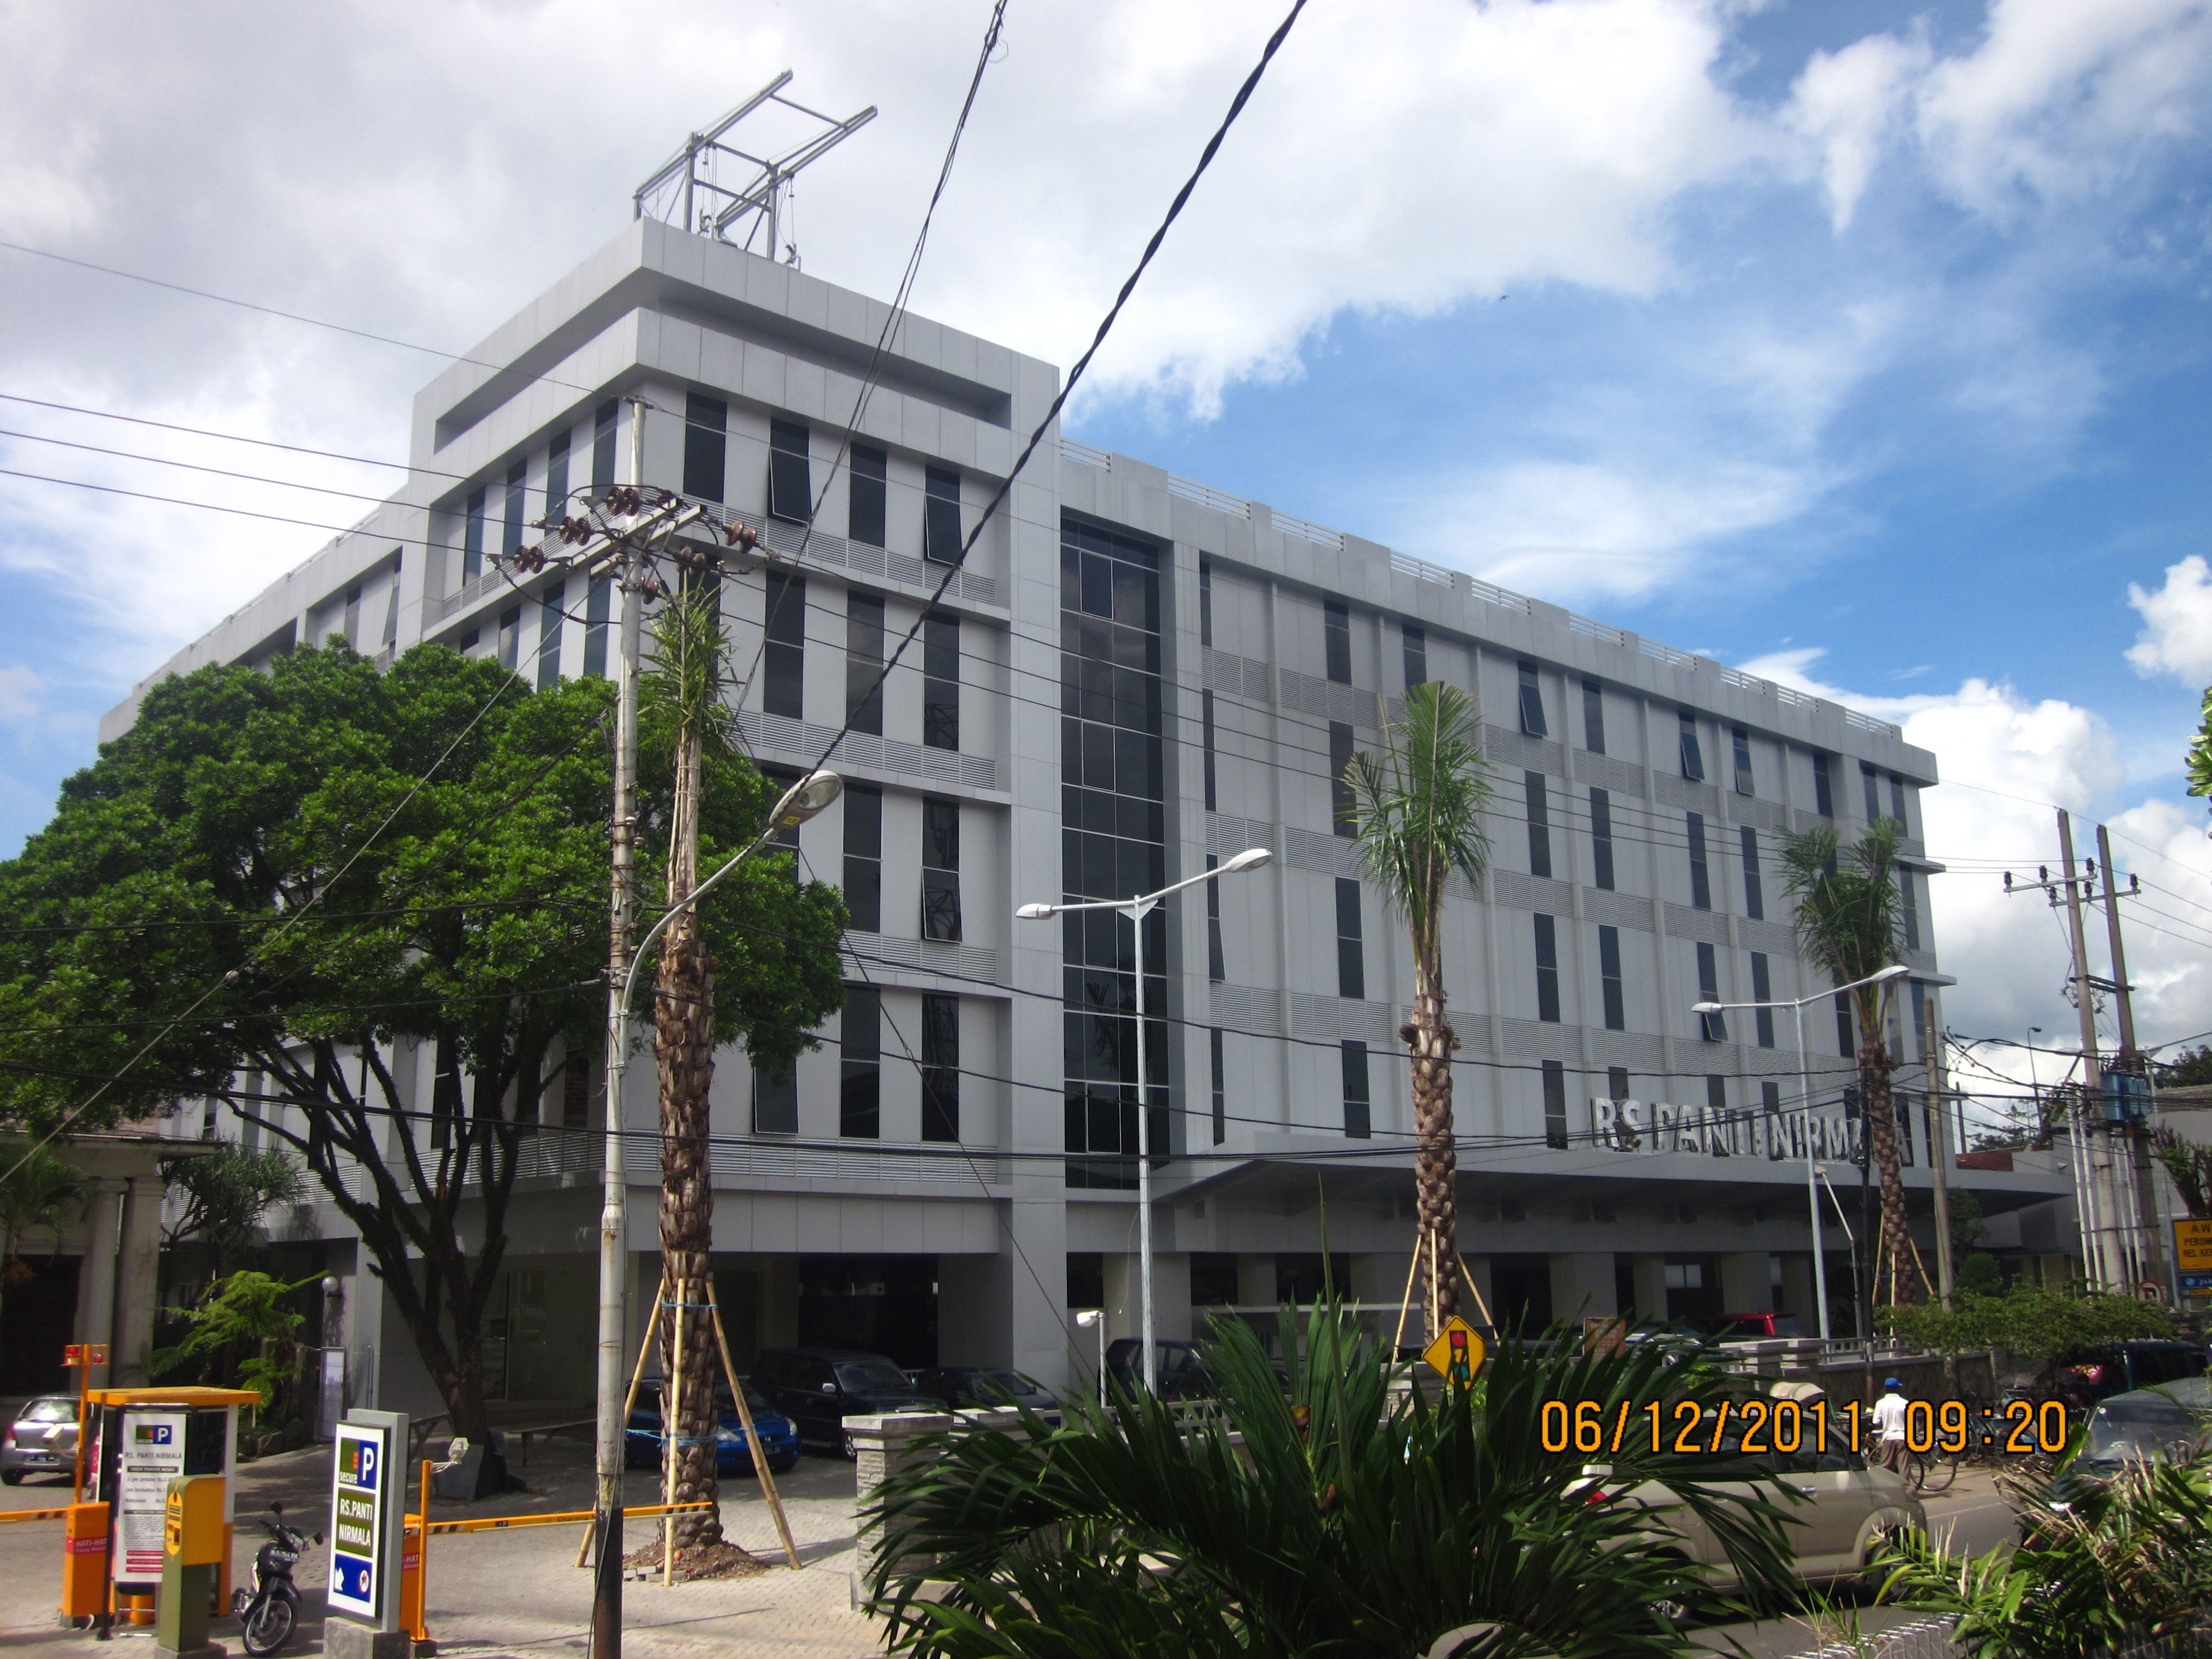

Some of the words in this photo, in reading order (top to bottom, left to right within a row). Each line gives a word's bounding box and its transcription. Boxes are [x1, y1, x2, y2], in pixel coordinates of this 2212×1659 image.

[1767, 1111, 1914, 1167] NIRMA
[159, 1428, 169, 1442] P
[362, 1446, 374, 1481] P
[75, 1537, 107, 1548] HATI-HAT
[339, 1523, 371, 1547] NIRMALA
